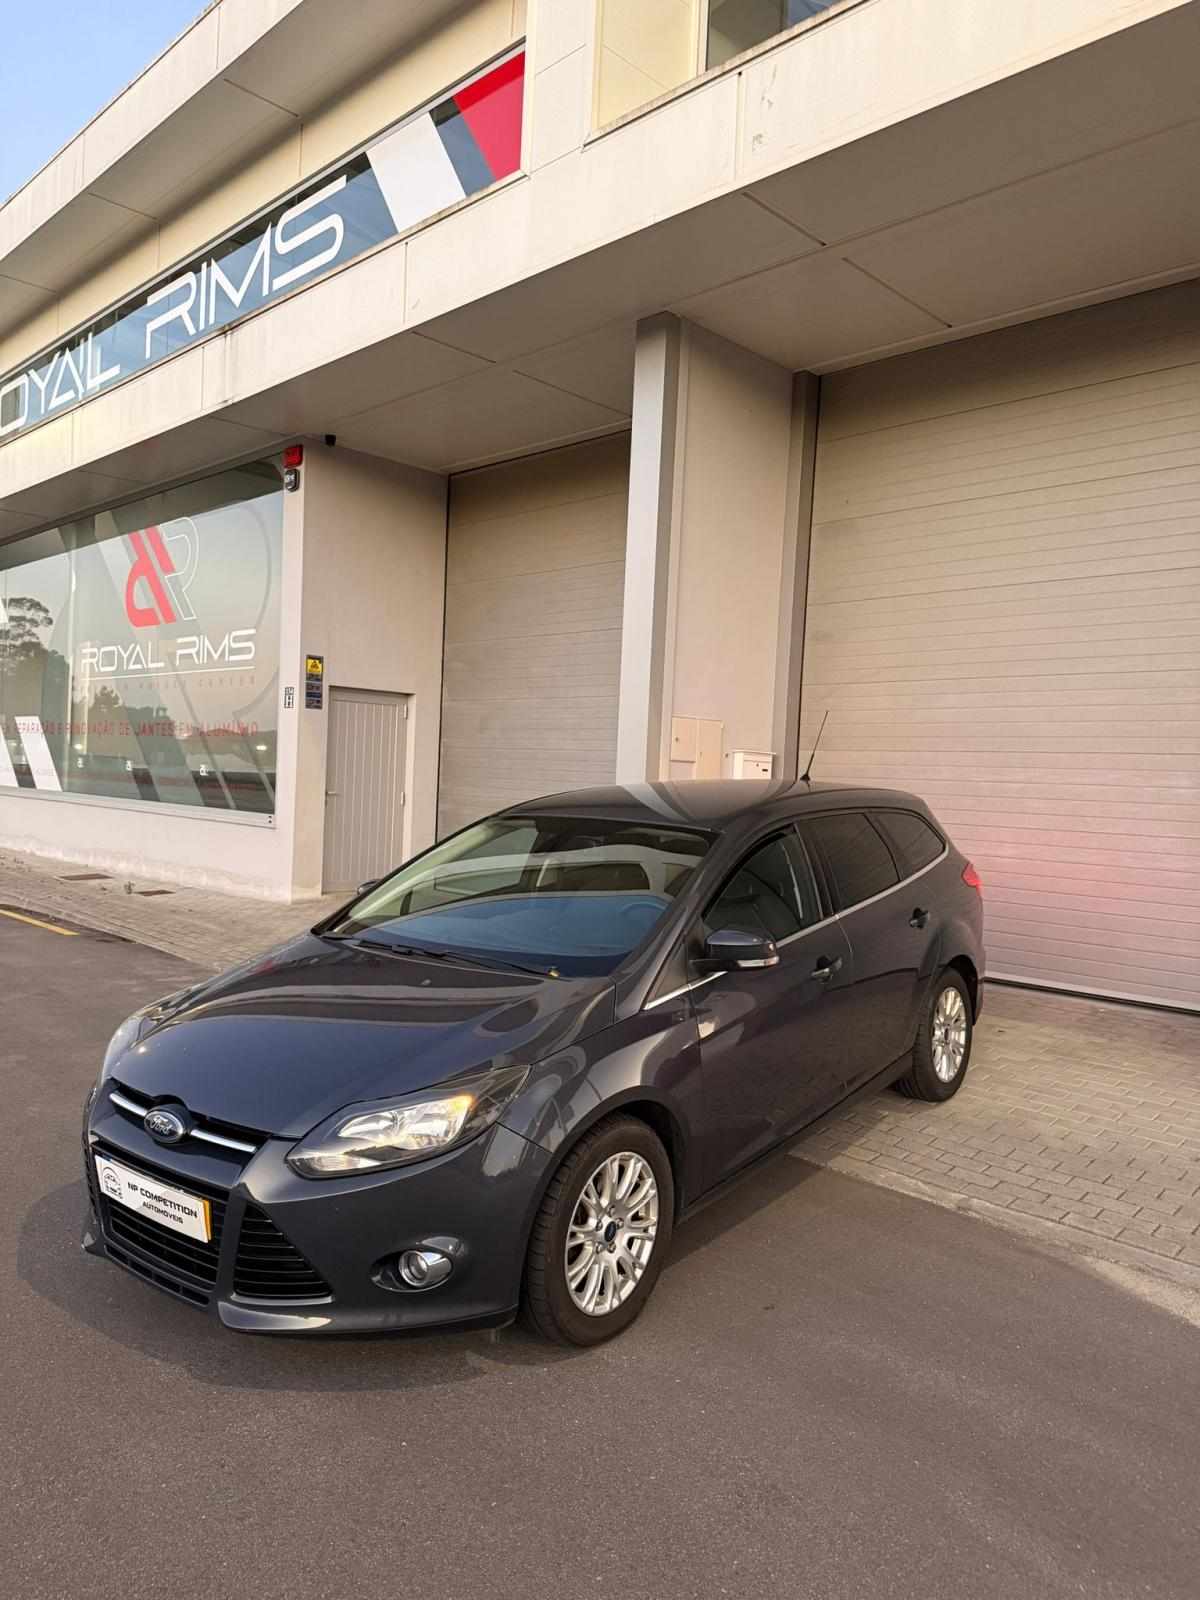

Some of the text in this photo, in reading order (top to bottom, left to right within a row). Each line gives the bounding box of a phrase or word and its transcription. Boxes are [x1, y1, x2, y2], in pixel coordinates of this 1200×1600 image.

[0, 174, 347, 436] OYAL RIMS
[80, 628, 256, 673] ROYAL RIMS
[149, 1114, 174, 1136] Ford
[127, 1181, 138, 1193] NP
[140, 1187, 198, 1219] COMPETITION
